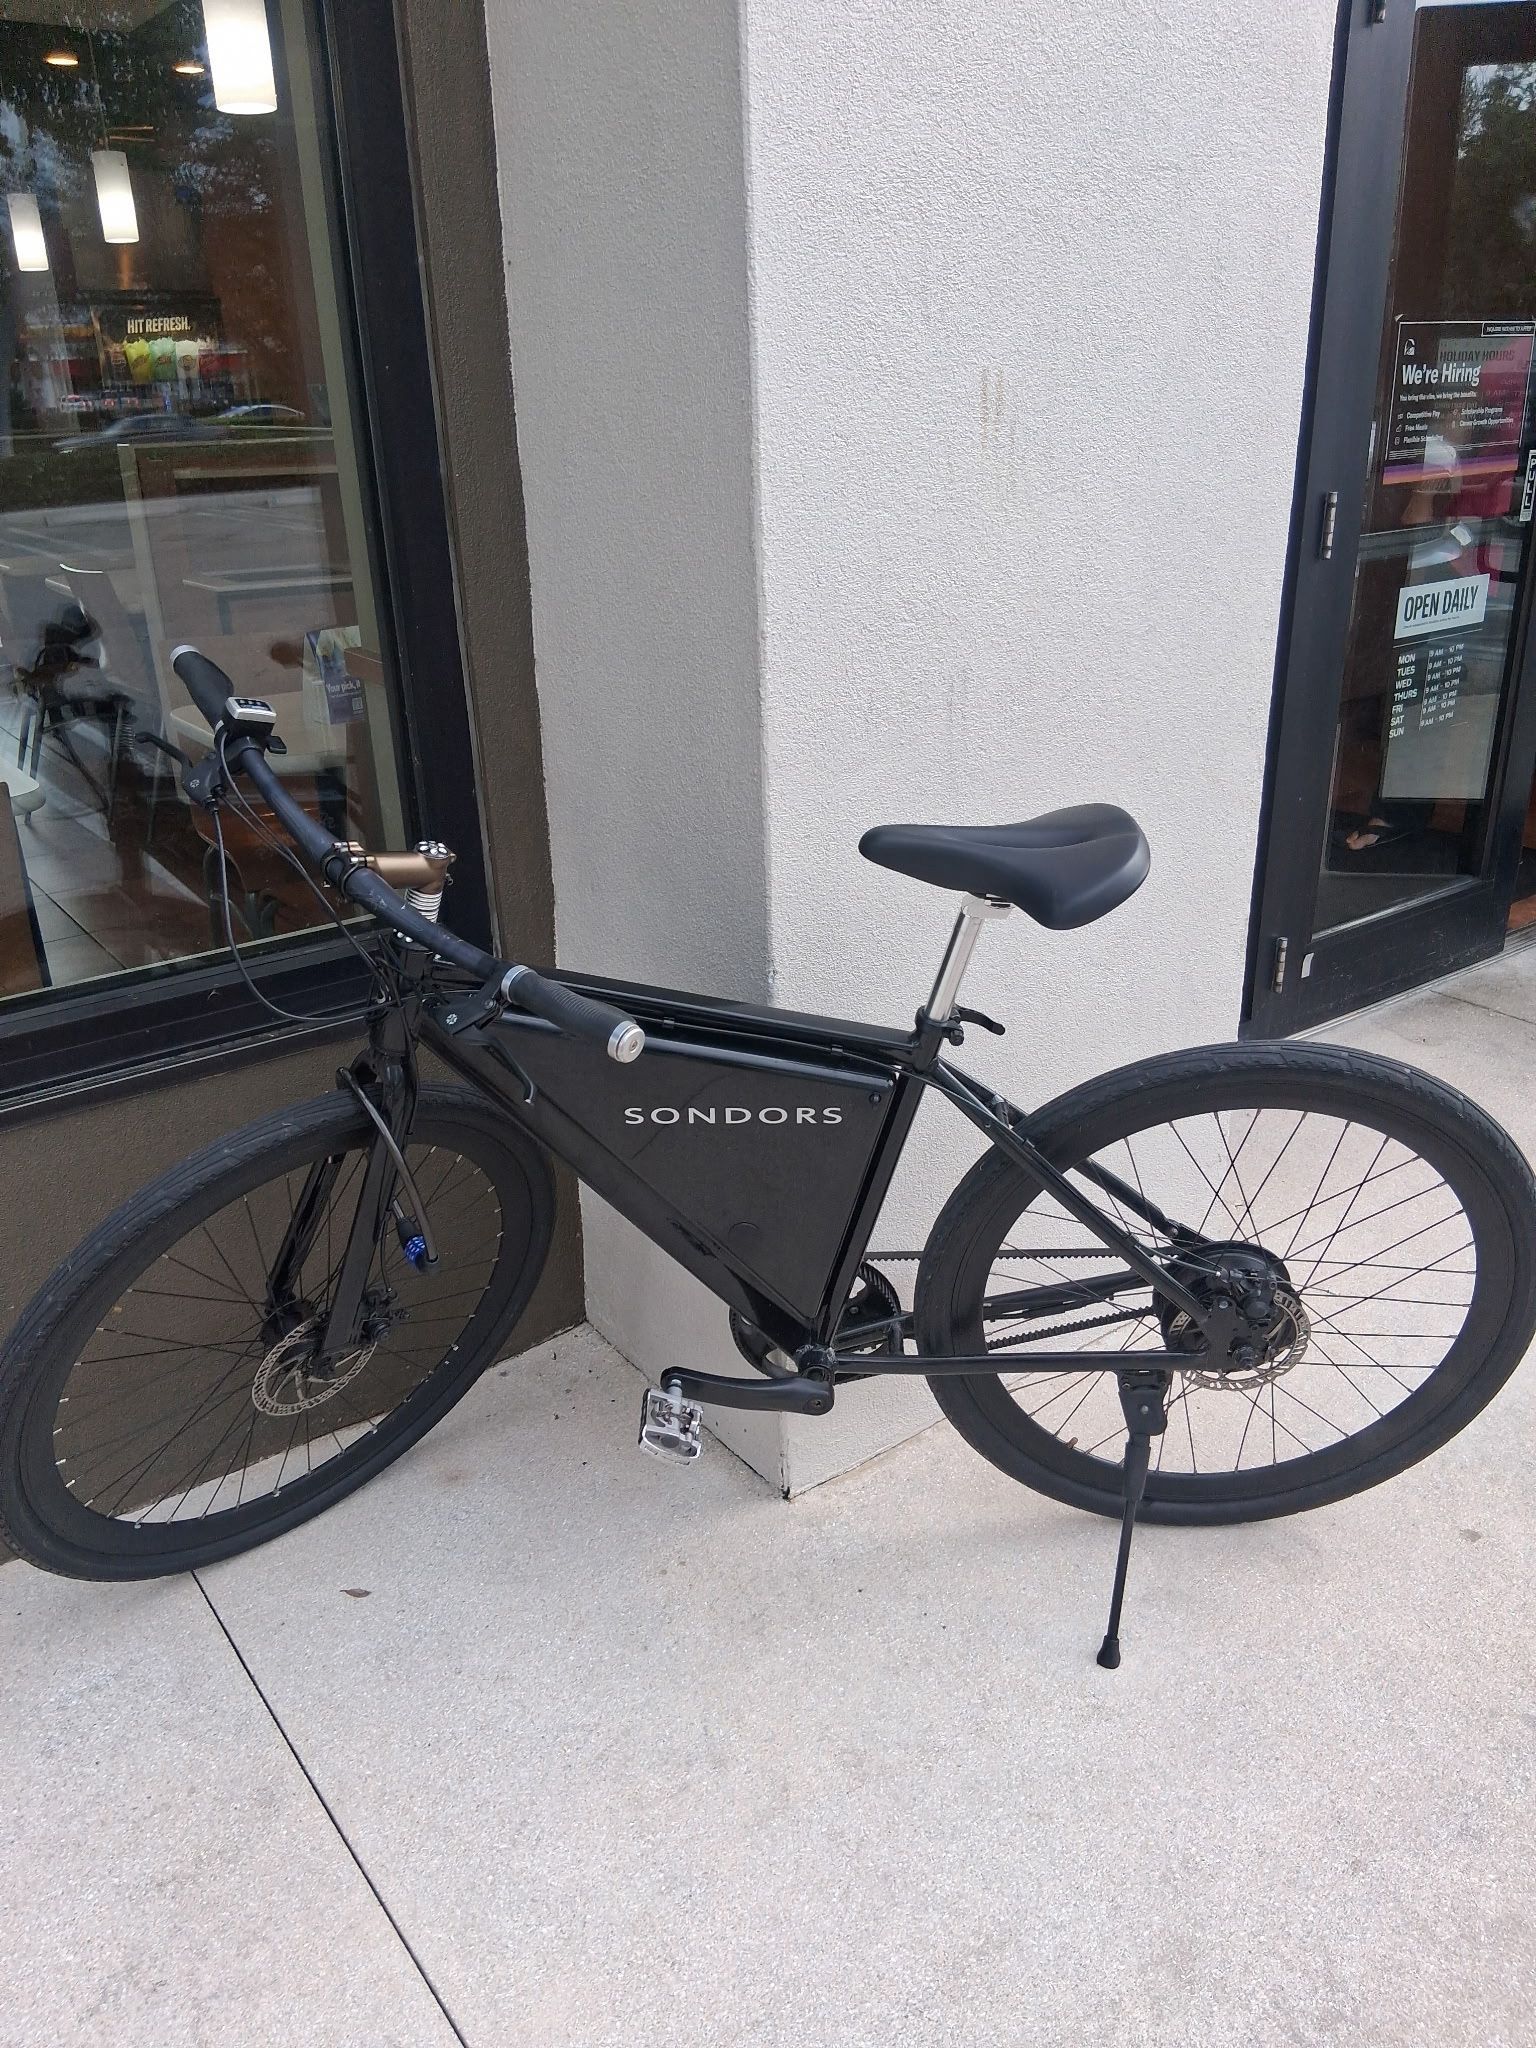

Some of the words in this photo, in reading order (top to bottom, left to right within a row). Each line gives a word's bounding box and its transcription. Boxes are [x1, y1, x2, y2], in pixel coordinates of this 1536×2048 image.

[127, 319, 144, 334] HIT
[1440, 350, 1480, 362] HOLIDAY
[1402, 364, 1438, 385] We're
[1441, 362, 1481, 387] Hiring
[1524, 458, 1536, 506] PULL
[1404, 592, 1440, 622] OPEN
[1442, 584, 1479, 615] DAILY
[1397, 665, 1416, 677] TUES
[1454, 655, 1463, 663] PM
[1398, 653, 1416, 665] MON
[1394, 689, 1418, 701] THURS
[1430, 684, 1439, 693] AM
[1451, 678, 1459, 686] PM
[1395, 678, 1412, 689] WED
[1392, 704, 1403, 714] FRI
[1428, 696, 1437, 704] AM
[1390, 715, 1405, 726] SAT
[1427, 705, 1436, 713] AM
[1388, 727, 1404, 738] SUN
[1425, 718, 1434, 726] AM
[624, 1107, 843, 1125] SONDORS
